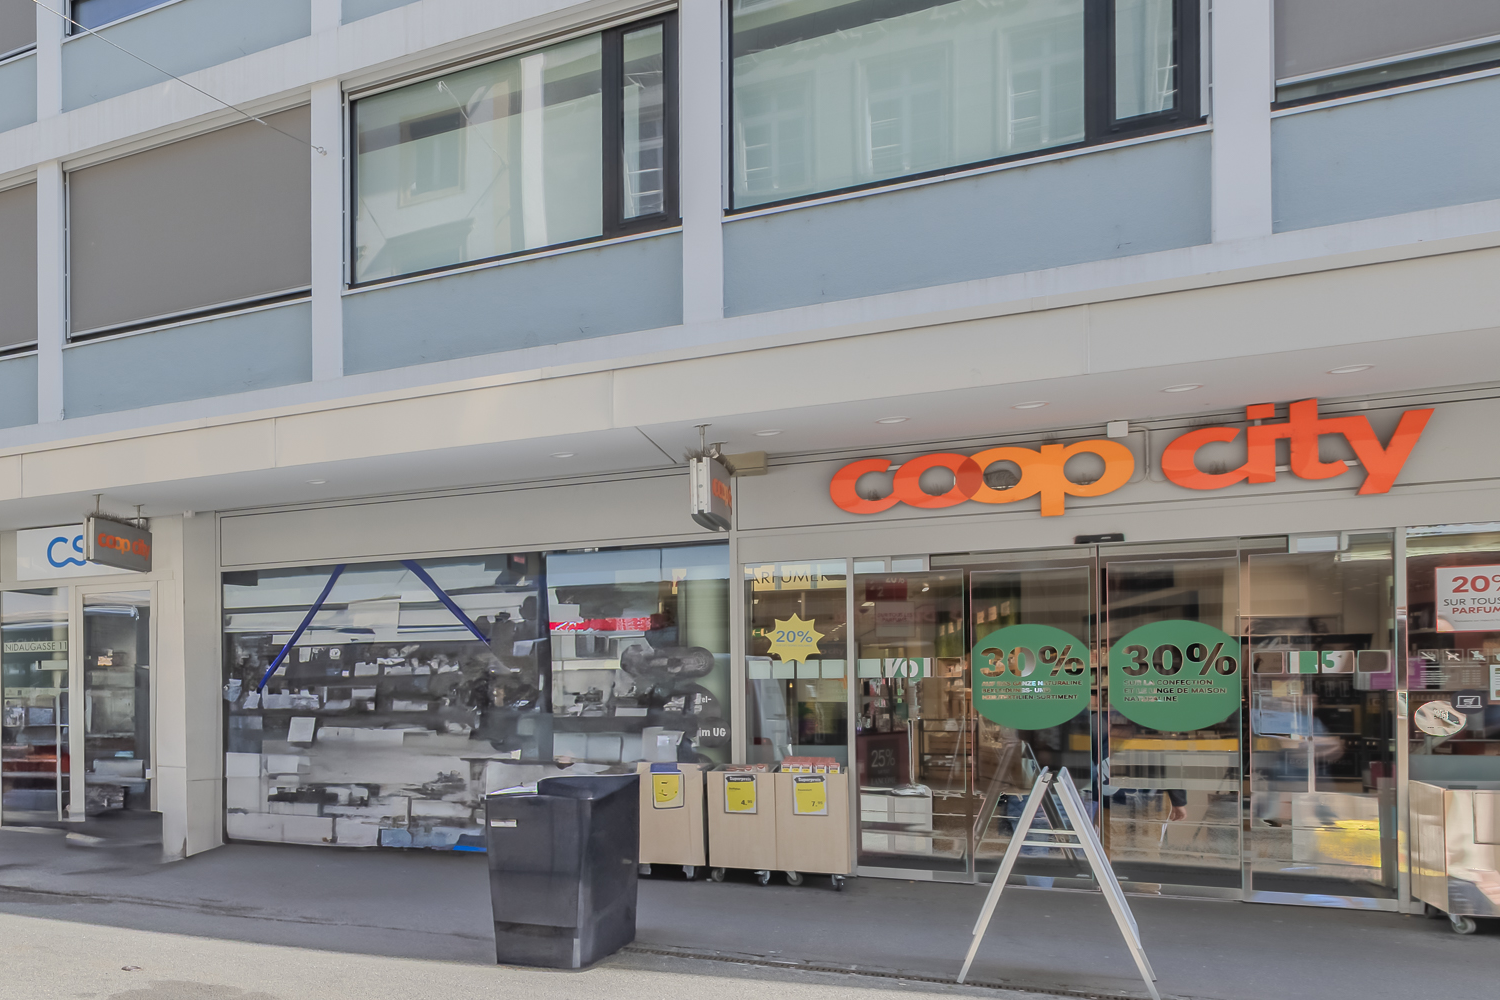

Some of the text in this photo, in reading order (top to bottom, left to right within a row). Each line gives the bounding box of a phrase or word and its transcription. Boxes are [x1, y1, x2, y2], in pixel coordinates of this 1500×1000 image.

[829, 398, 1435, 517] coop city
[98, 533, 151, 561] coop city
[1443, 598, 1467, 606] SUR
[776, 630, 813, 643] 20%
[5, 642, 67, 651] NIDAUGASSE 11
[980, 644, 1086, 678] 30%
[1121, 642, 1238, 677] 30%
[699, 727, 726, 737] im UG
[871, 748, 896, 767] 25%
